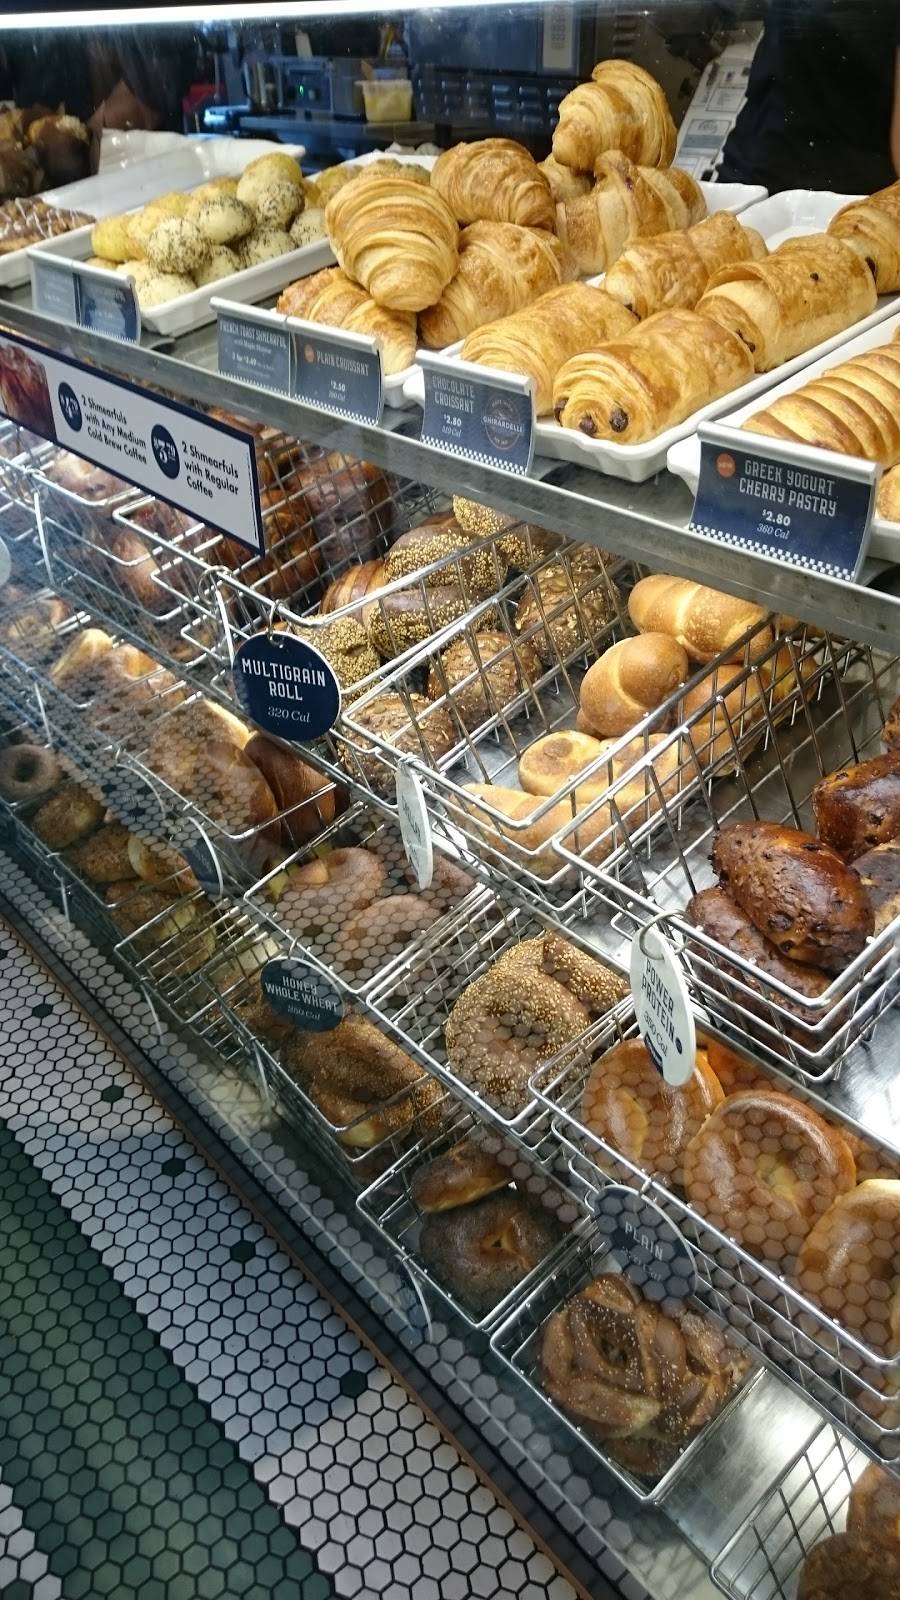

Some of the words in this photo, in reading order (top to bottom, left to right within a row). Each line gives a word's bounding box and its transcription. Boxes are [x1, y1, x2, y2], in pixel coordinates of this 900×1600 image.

[316, 350, 335, 367] PLAIN
[336, 356, 369, 376] CROISSANT
[432, 375, 475, 399] CHOCOLATE
[81, 394, 87, 407] 2
[88, 397, 127, 425] Shmearfuls
[434, 391, 475, 414] CROISSANT
[84, 413, 100, 427] with
[101, 418, 115, 437] Any
[117, 426, 147, 449] Medium
[444, 414, 462, 428] $2.80
[482, 415, 523, 433] GHIRARDELLI
[87, 426, 103, 442] Cold
[104, 434, 122, 452] Brew
[123, 444, 147, 464] Coffee
[182, 440, 188, 454] 2
[189, 444, 239, 479] Shmearfuls
[184, 461, 203, 478] with
[205, 468, 239, 495] Regular
[186, 475, 213, 498] Coffee
[744, 460, 782, 483] GREEK
[787, 470, 836, 496] YOGURT
[740, 478, 786, 503] CHERRY
[788, 490, 837, 517] PASTRY
[757, 523, 773, 535] 360
[774, 528, 790, 540] Cal
[762, 509, 791, 527] $2.80
[241, 657, 326, 687] MULTIGRAIN
[269, 680, 303, 701] ROLL
[267, 706, 289, 720] 320
[291, 710, 310, 723] Cal
[265, 982, 301, 1002] WHOLE
[301, 993, 337, 1012] WHEAT
[282, 975, 317, 995] HONEY
[645, 960, 674, 1018] POWER
[641, 973, 676, 1042] PROTEIN
[656, 1033, 668, 1056] Cal
[625, 1221, 663, 1261] PLAIN
